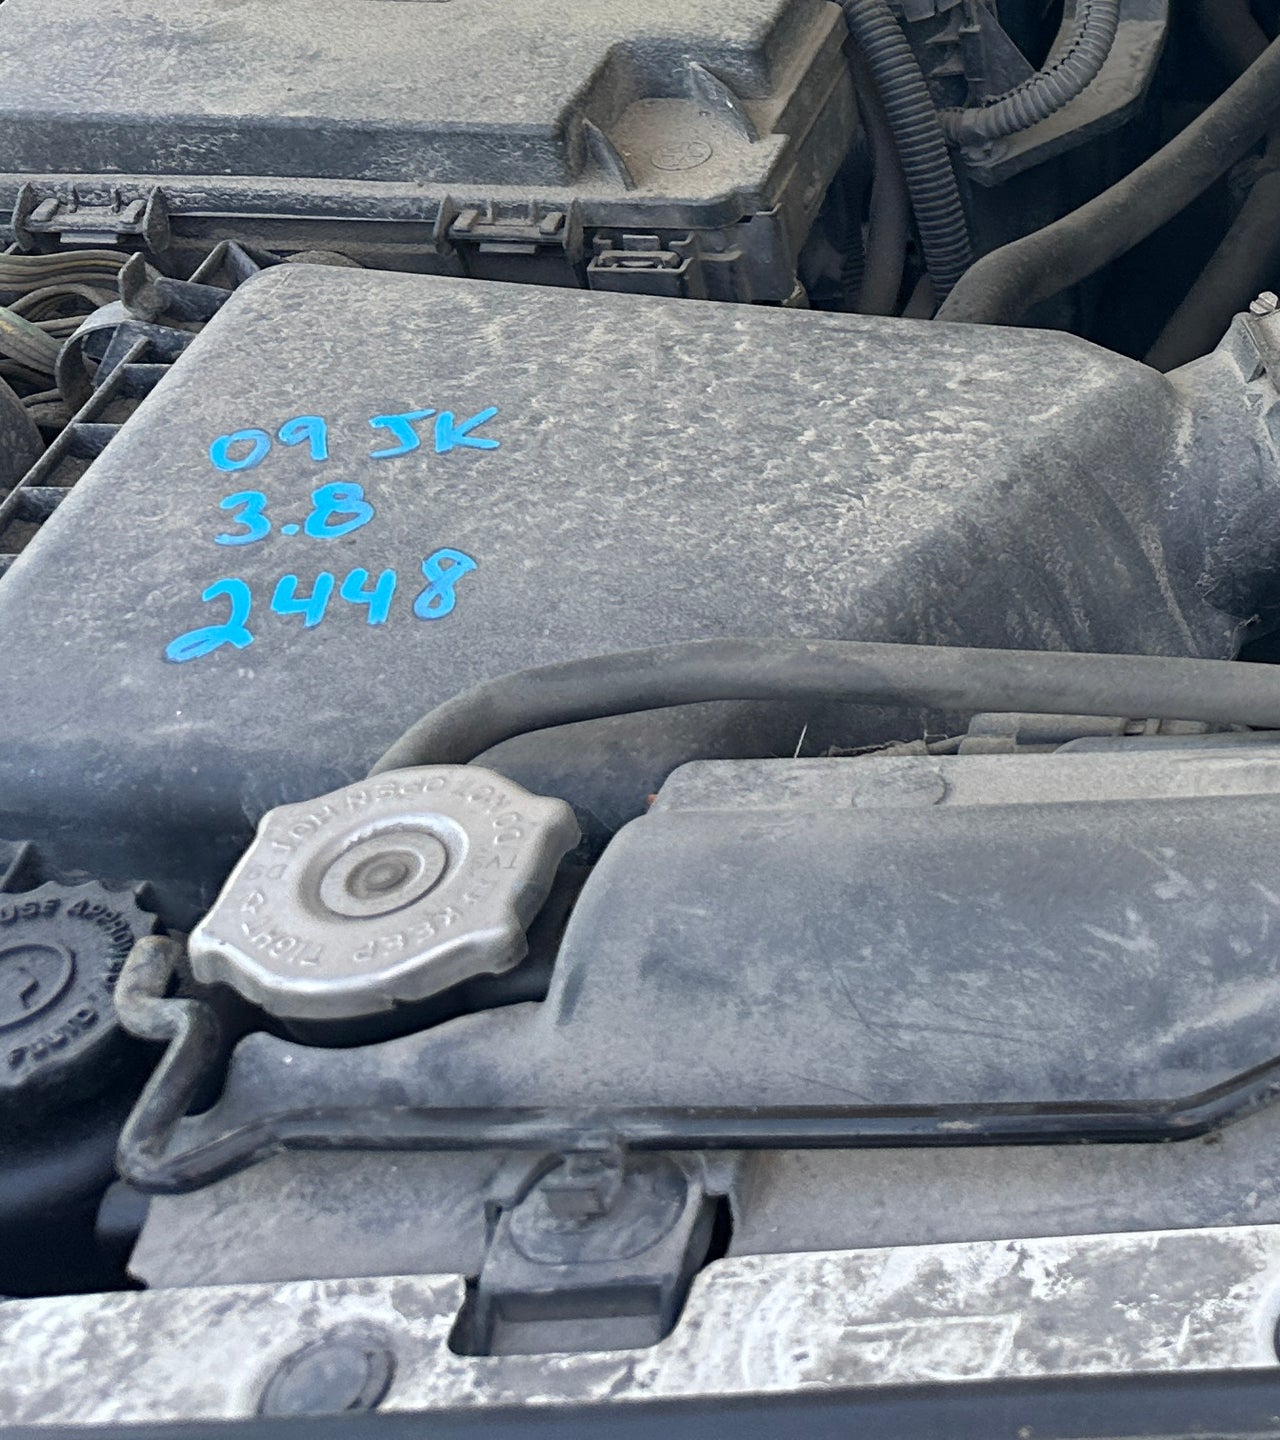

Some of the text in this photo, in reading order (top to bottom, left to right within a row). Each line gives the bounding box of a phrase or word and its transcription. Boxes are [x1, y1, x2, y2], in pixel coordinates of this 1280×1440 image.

[209, 407, 499, 471] 09 JK
[214, 482, 375, 546] 3.8
[162, 548, 478, 663] 2448
[240, 906, 460, 968] KEEP TIGHT
